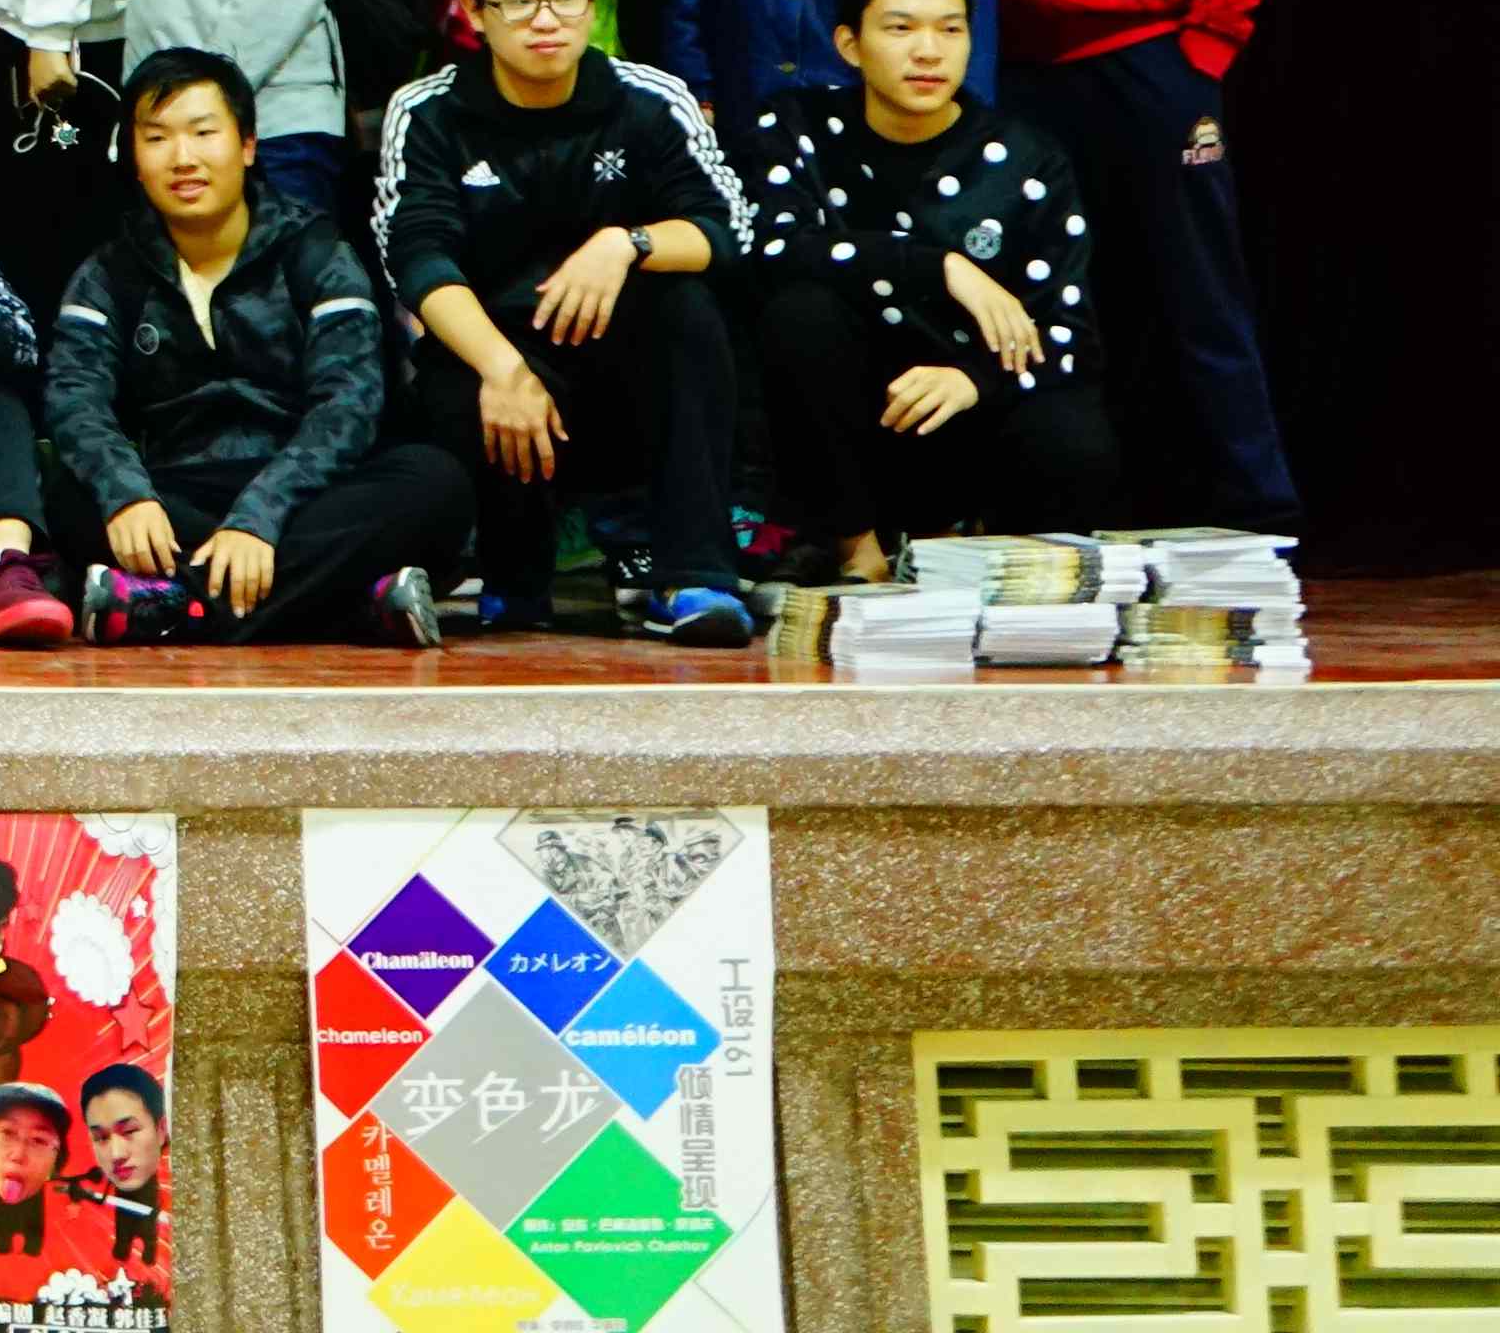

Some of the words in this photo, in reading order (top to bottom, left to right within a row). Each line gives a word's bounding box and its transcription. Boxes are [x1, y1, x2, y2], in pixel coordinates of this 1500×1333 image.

[360, 951, 475, 970] Chamäleon
[508, 951, 611, 973] カメレオン
[316, 1027, 423, 1045] chameleon
[565, 1022, 697, 1046] caméléon
[402, 1070, 601, 1141] 变色龙
[679, 1066, 719, 1210] 倾情呈现
[362, 1118, 396, 1251] 카멜레온
